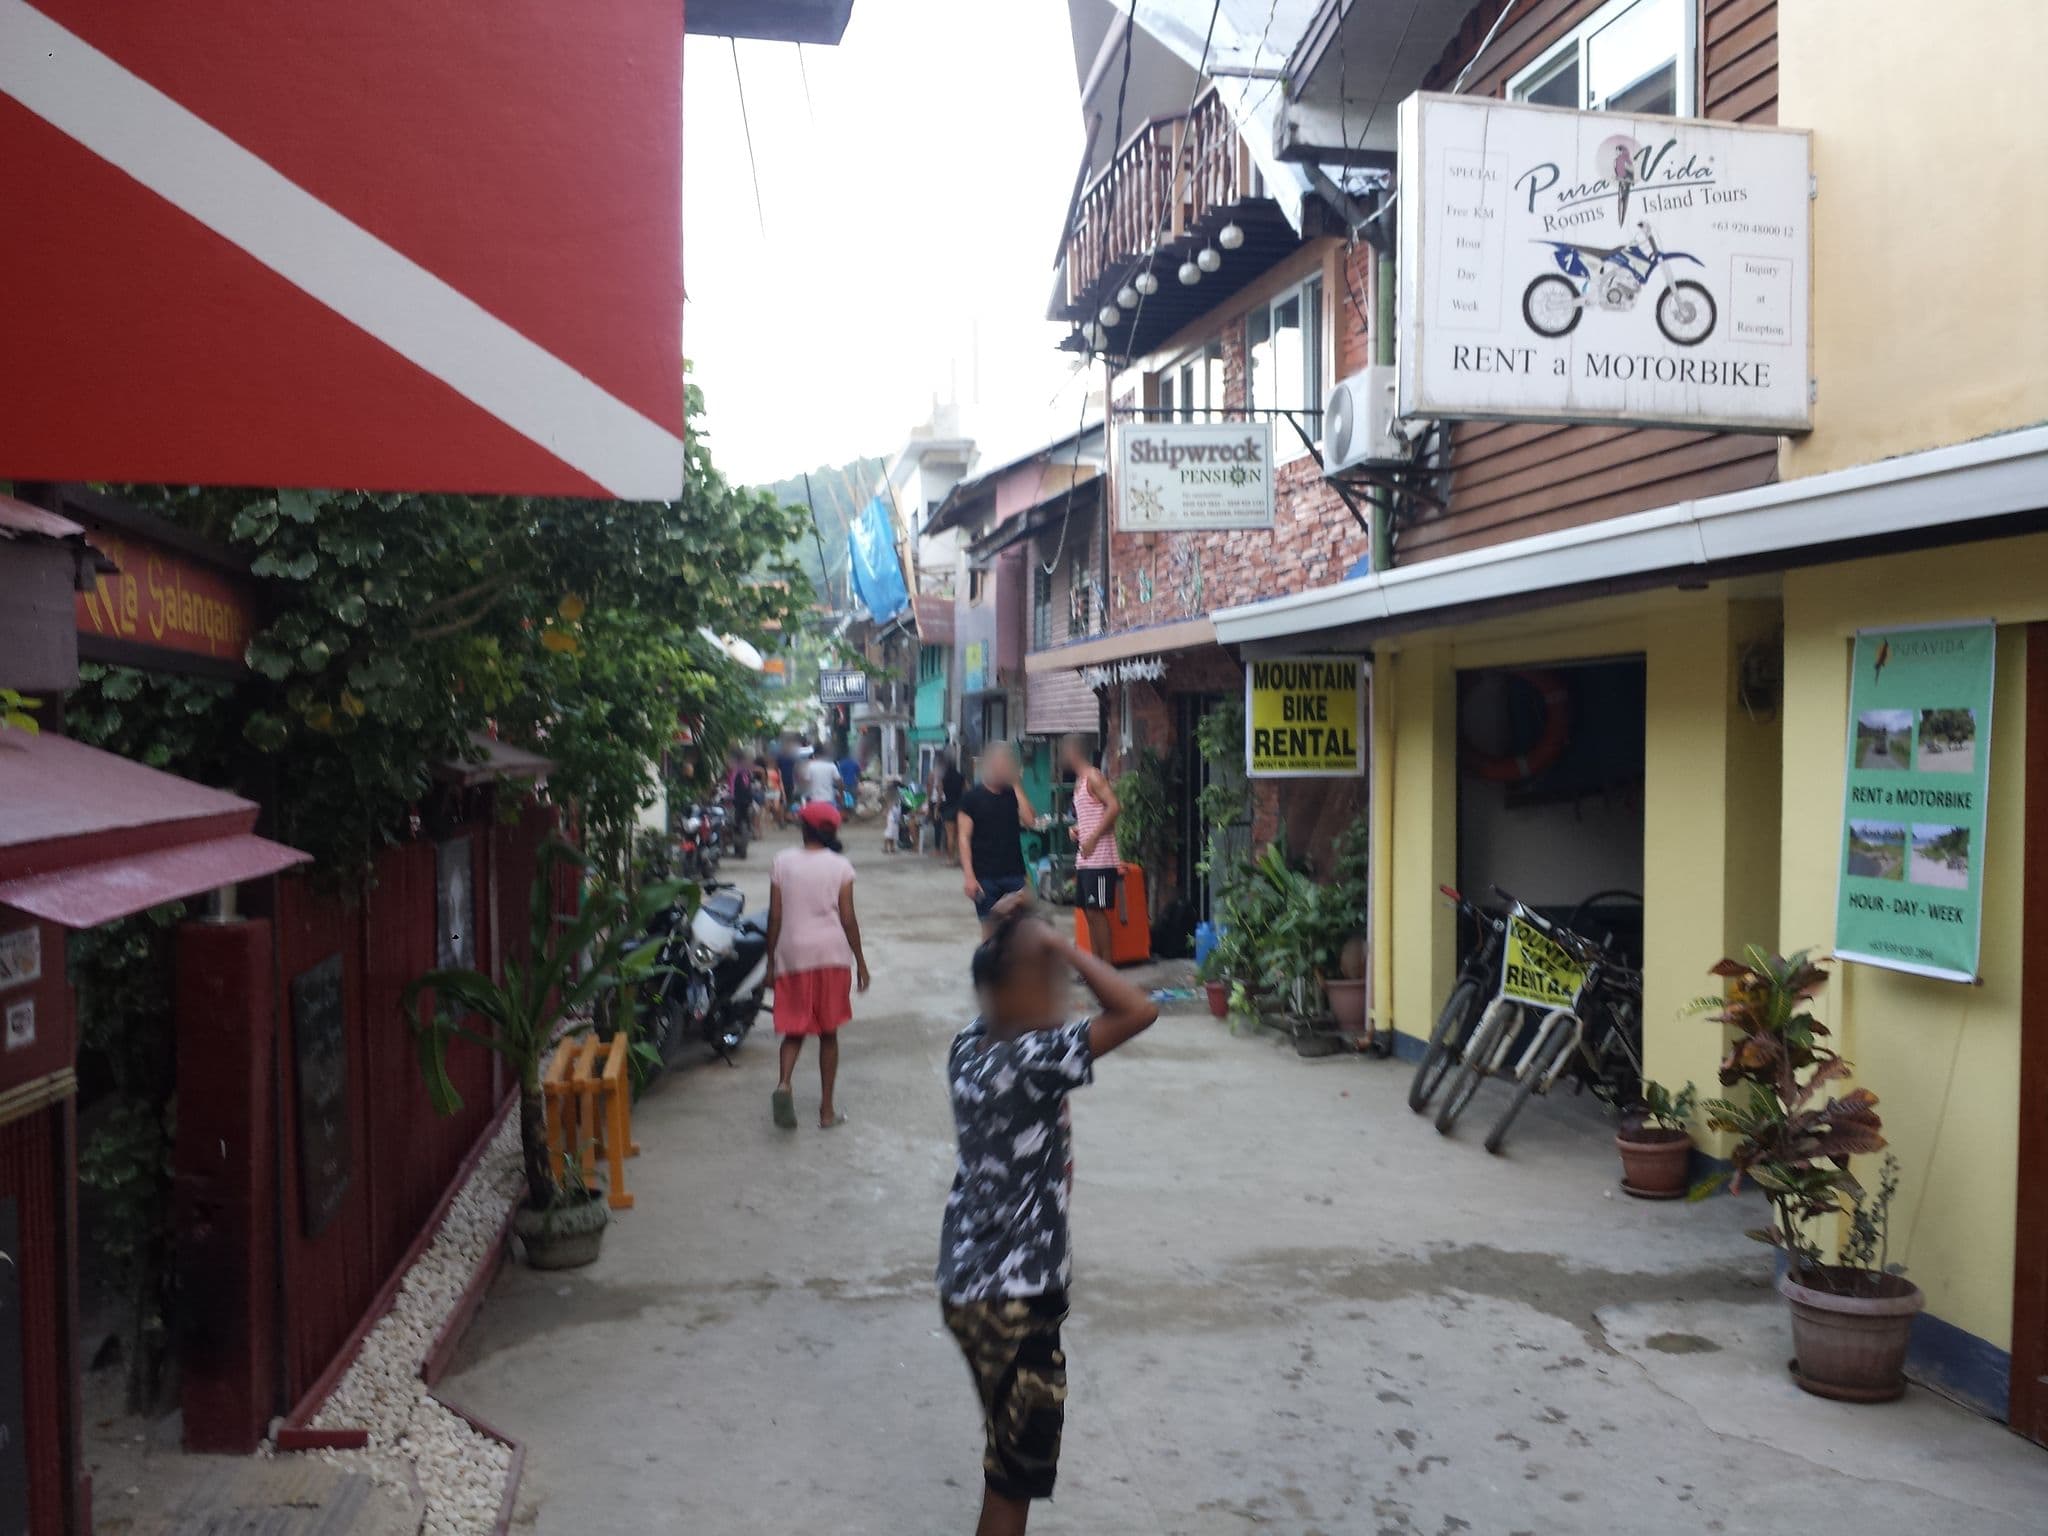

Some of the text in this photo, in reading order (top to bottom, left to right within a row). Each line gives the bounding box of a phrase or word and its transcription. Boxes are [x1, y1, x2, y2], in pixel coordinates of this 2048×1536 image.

[1449, 167, 1498, 181] SPECIAL
[1514, 138, 1712, 214] Pura Vida
[1543, 187, 1747, 232] Rooms Island Tours
[1456, 237, 1481, 249] Hour
[1457, 268, 1476, 281] Day
[1452, 300, 1479, 311] Week
[1756, 296, 1766, 304] at
[1737, 321, 1784, 336] Reception
[1453, 344, 1771, 388] RENT a MOTORBIKE
[1130, 437, 1262, 469] Shipwreck
[1181, 466, 1262, 487] PENSION
[1253, 662, 1357, 690] MOUNTAIN
[1283, 695, 1328, 722] BIKE
[1254, 728, 1357, 757] RENTAL
[1851, 786, 1973, 811] RENT a MOTORBIKE
[1849, 895, 1885, 912] HOUR
[1893, 900, 1919, 917] DAY
[1928, 904, 1964, 924] WEEK
